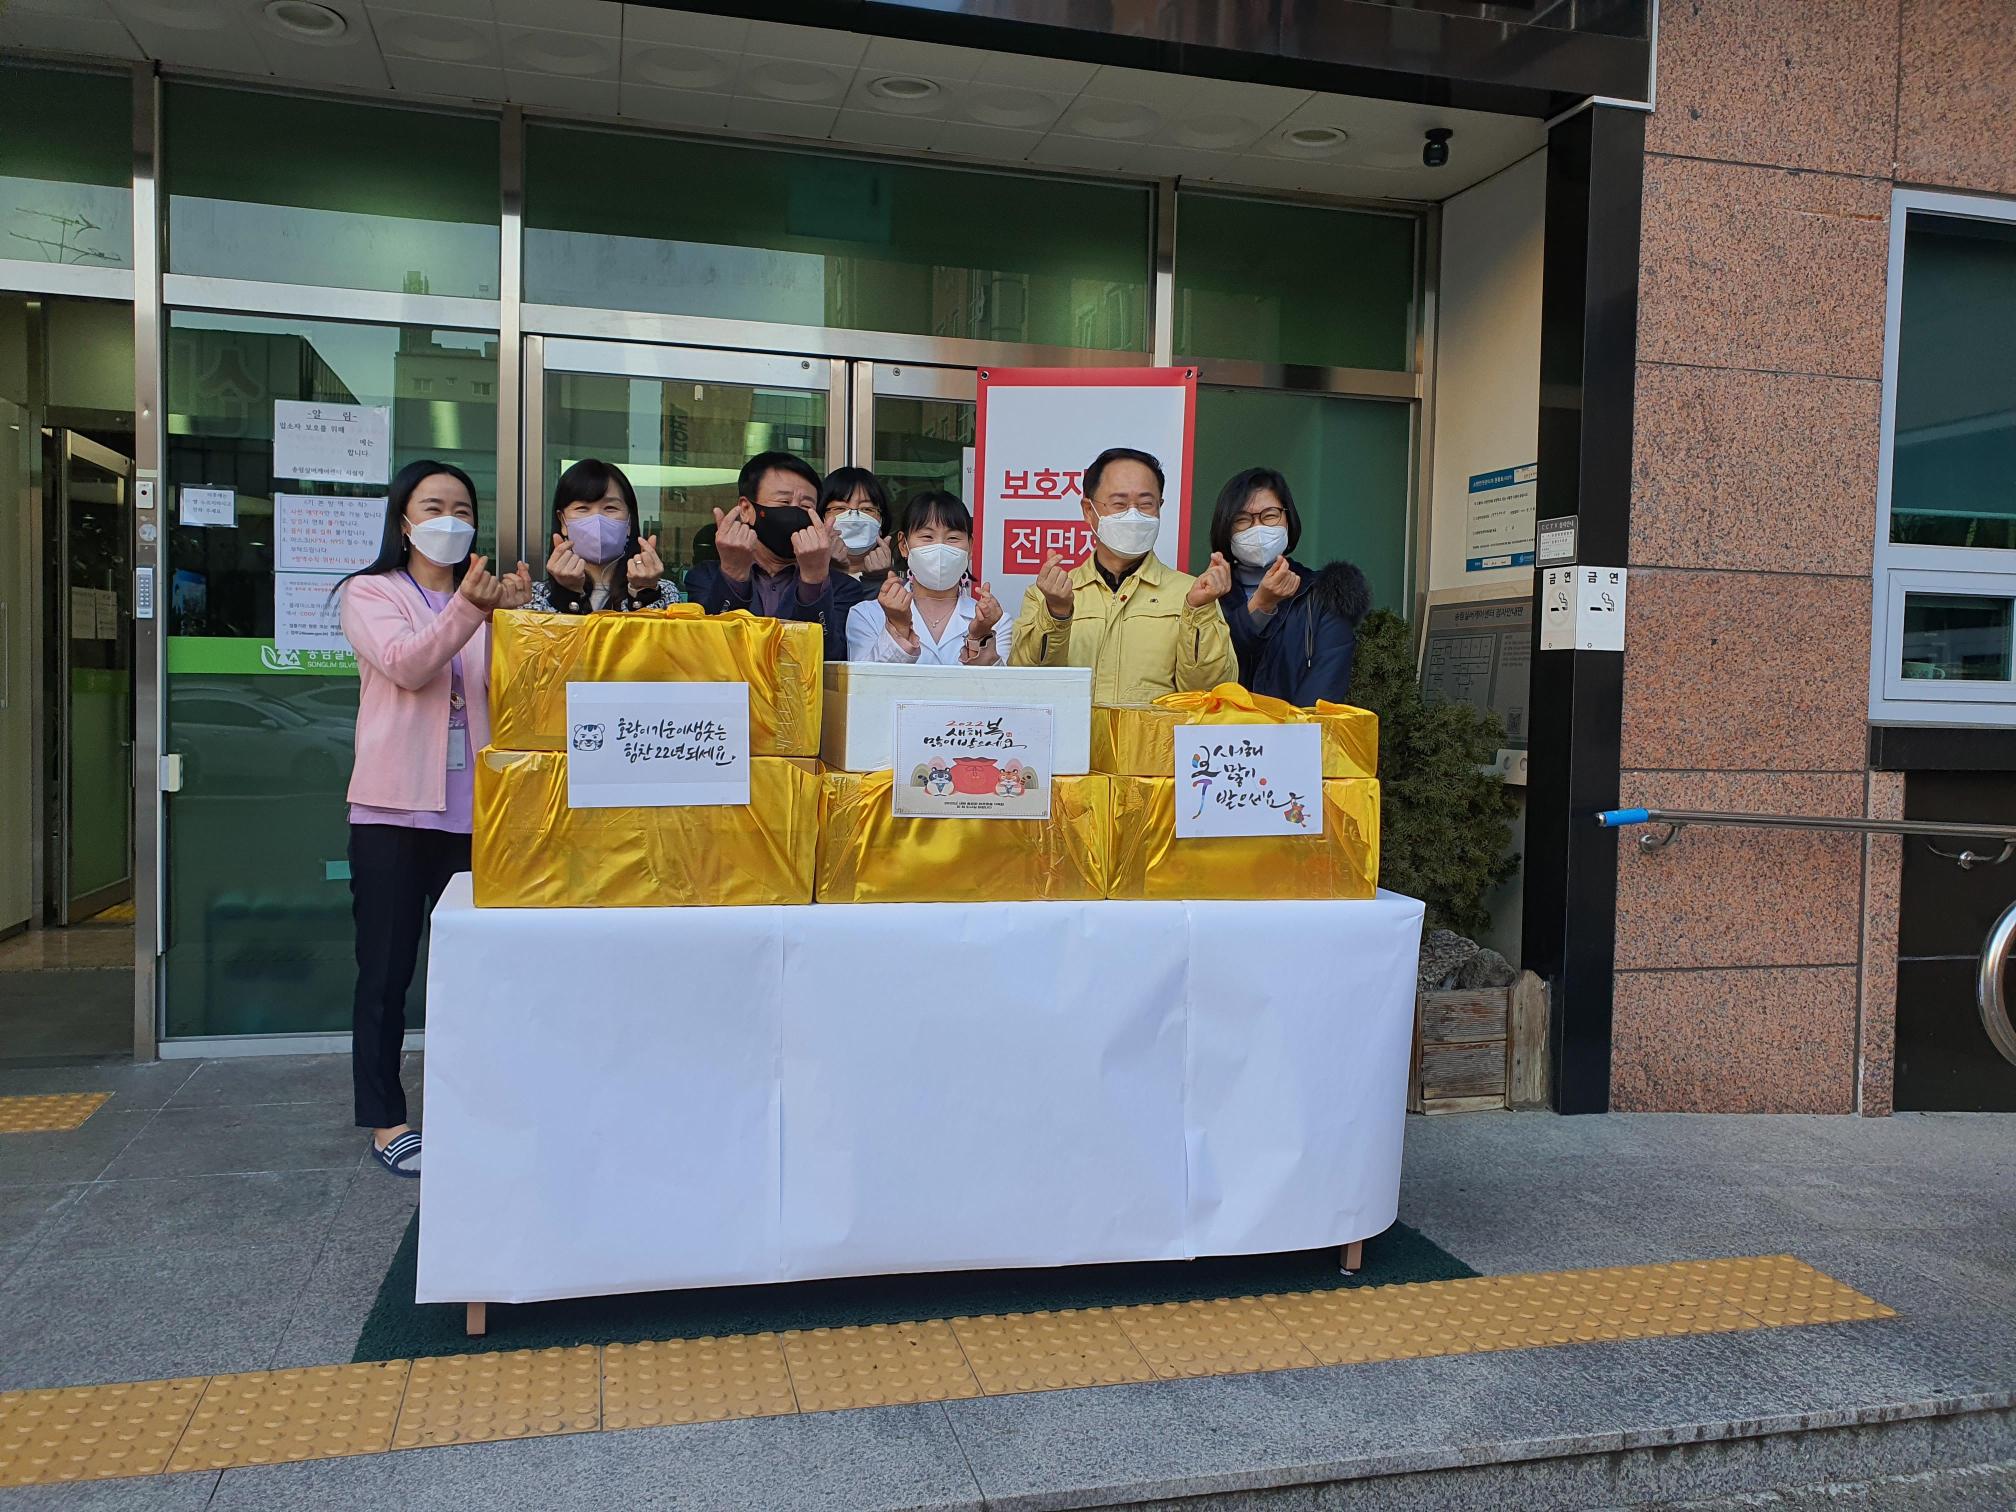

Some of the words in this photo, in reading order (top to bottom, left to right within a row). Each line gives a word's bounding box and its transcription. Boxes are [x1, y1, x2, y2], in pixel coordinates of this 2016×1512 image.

[616, 717, 650, 741] 호랑이
[651, 719, 687, 740] 기운이
[945, 727, 983, 738] 새해
[984, 717, 1005, 741] 복
[624, 742, 652, 764] 힘찬
[654, 742, 687, 761] 22년
[923, 736, 955, 748] 많이
[957, 737, 1028, 750] 받으세요
[1213, 739, 1264, 758] 새해
[1223, 763, 1256, 788] 많이
[1215, 789, 1293, 811] 받으세요
